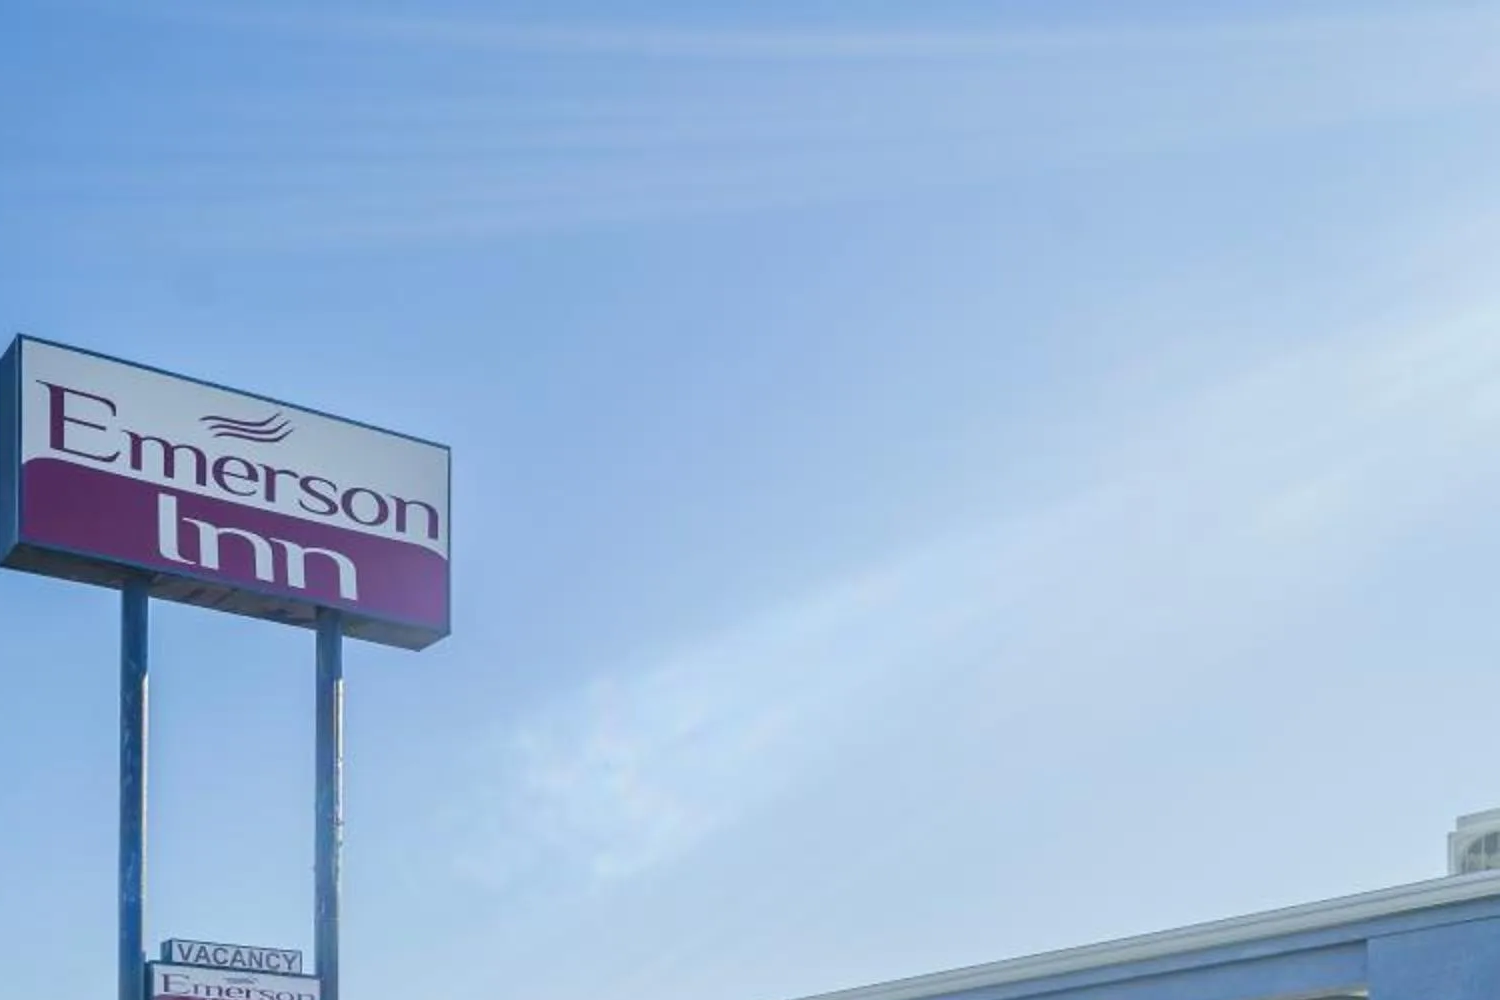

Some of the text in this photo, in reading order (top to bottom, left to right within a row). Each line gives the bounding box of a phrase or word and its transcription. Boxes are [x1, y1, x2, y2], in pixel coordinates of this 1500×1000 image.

[36, 379, 439, 540] Emerson
[157, 493, 358, 601] Inn
[177, 943, 298, 971] VACANCY
